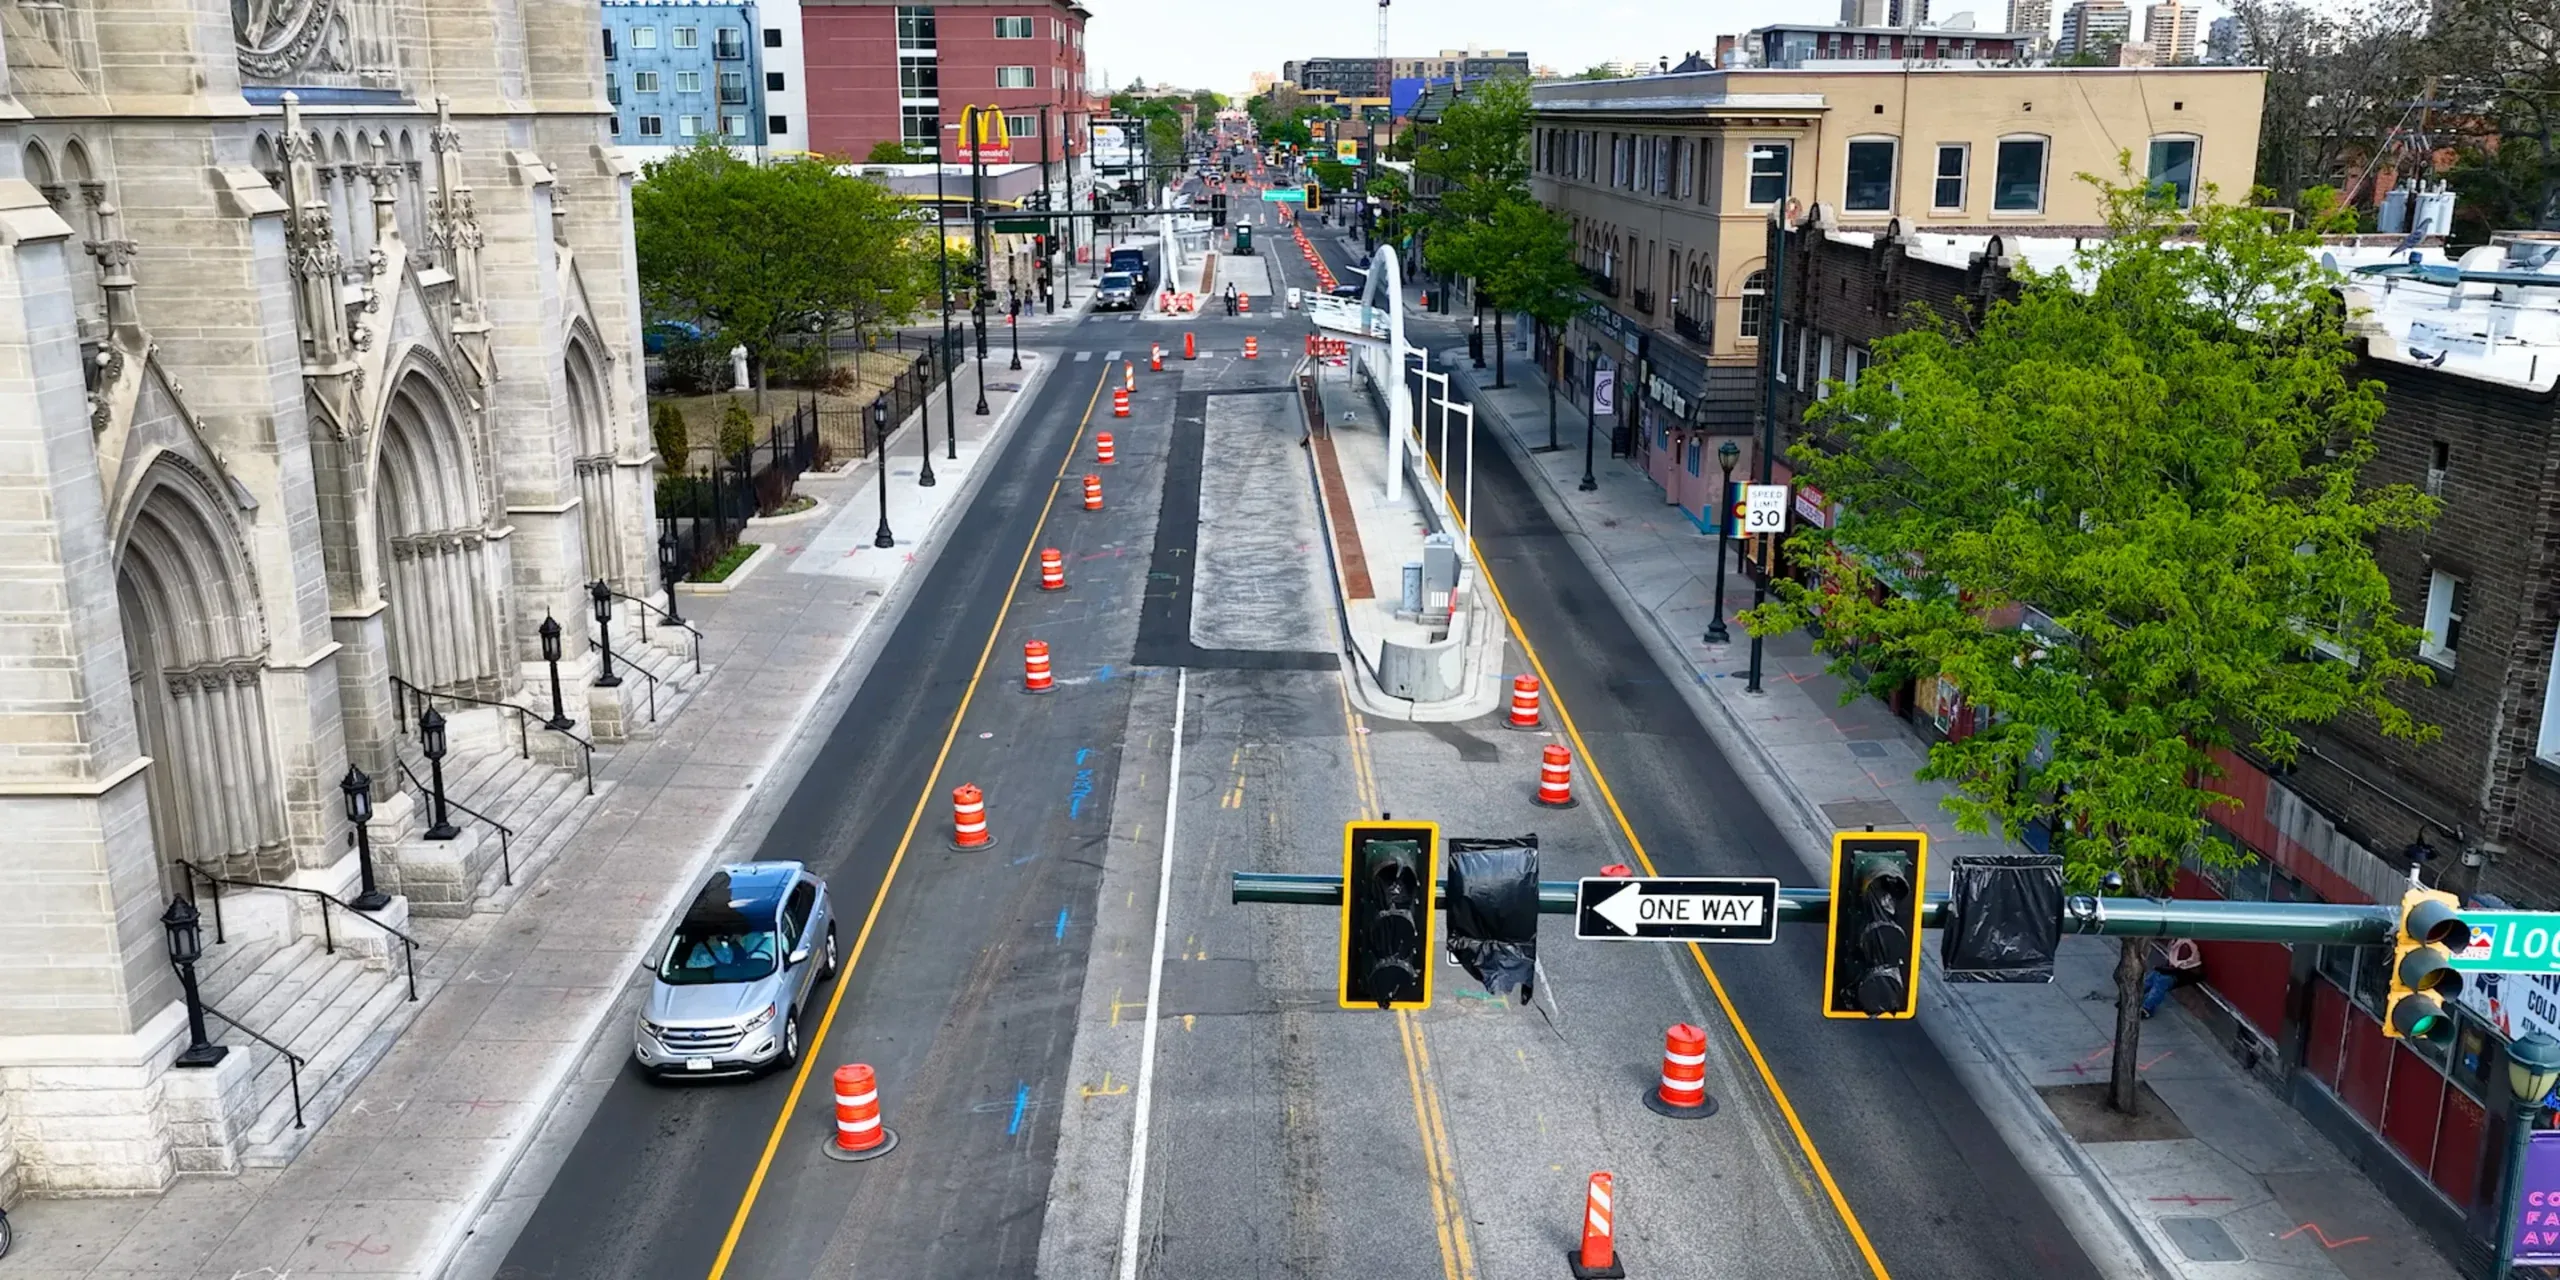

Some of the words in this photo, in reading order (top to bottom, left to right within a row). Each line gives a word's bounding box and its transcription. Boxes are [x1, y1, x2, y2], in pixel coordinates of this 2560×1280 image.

[958, 149, 1009, 158] Mconald's
[1752, 490, 1783, 499] SPEED
[1751, 510, 1780, 526] 30
[1640, 898, 1690, 920] ONE
[1702, 899, 1754, 921] WAY
[2527, 989, 2557, 1025] COLD
[2526, 1211, 2560, 1225] FA
[2522, 1231, 2560, 1246] AV
